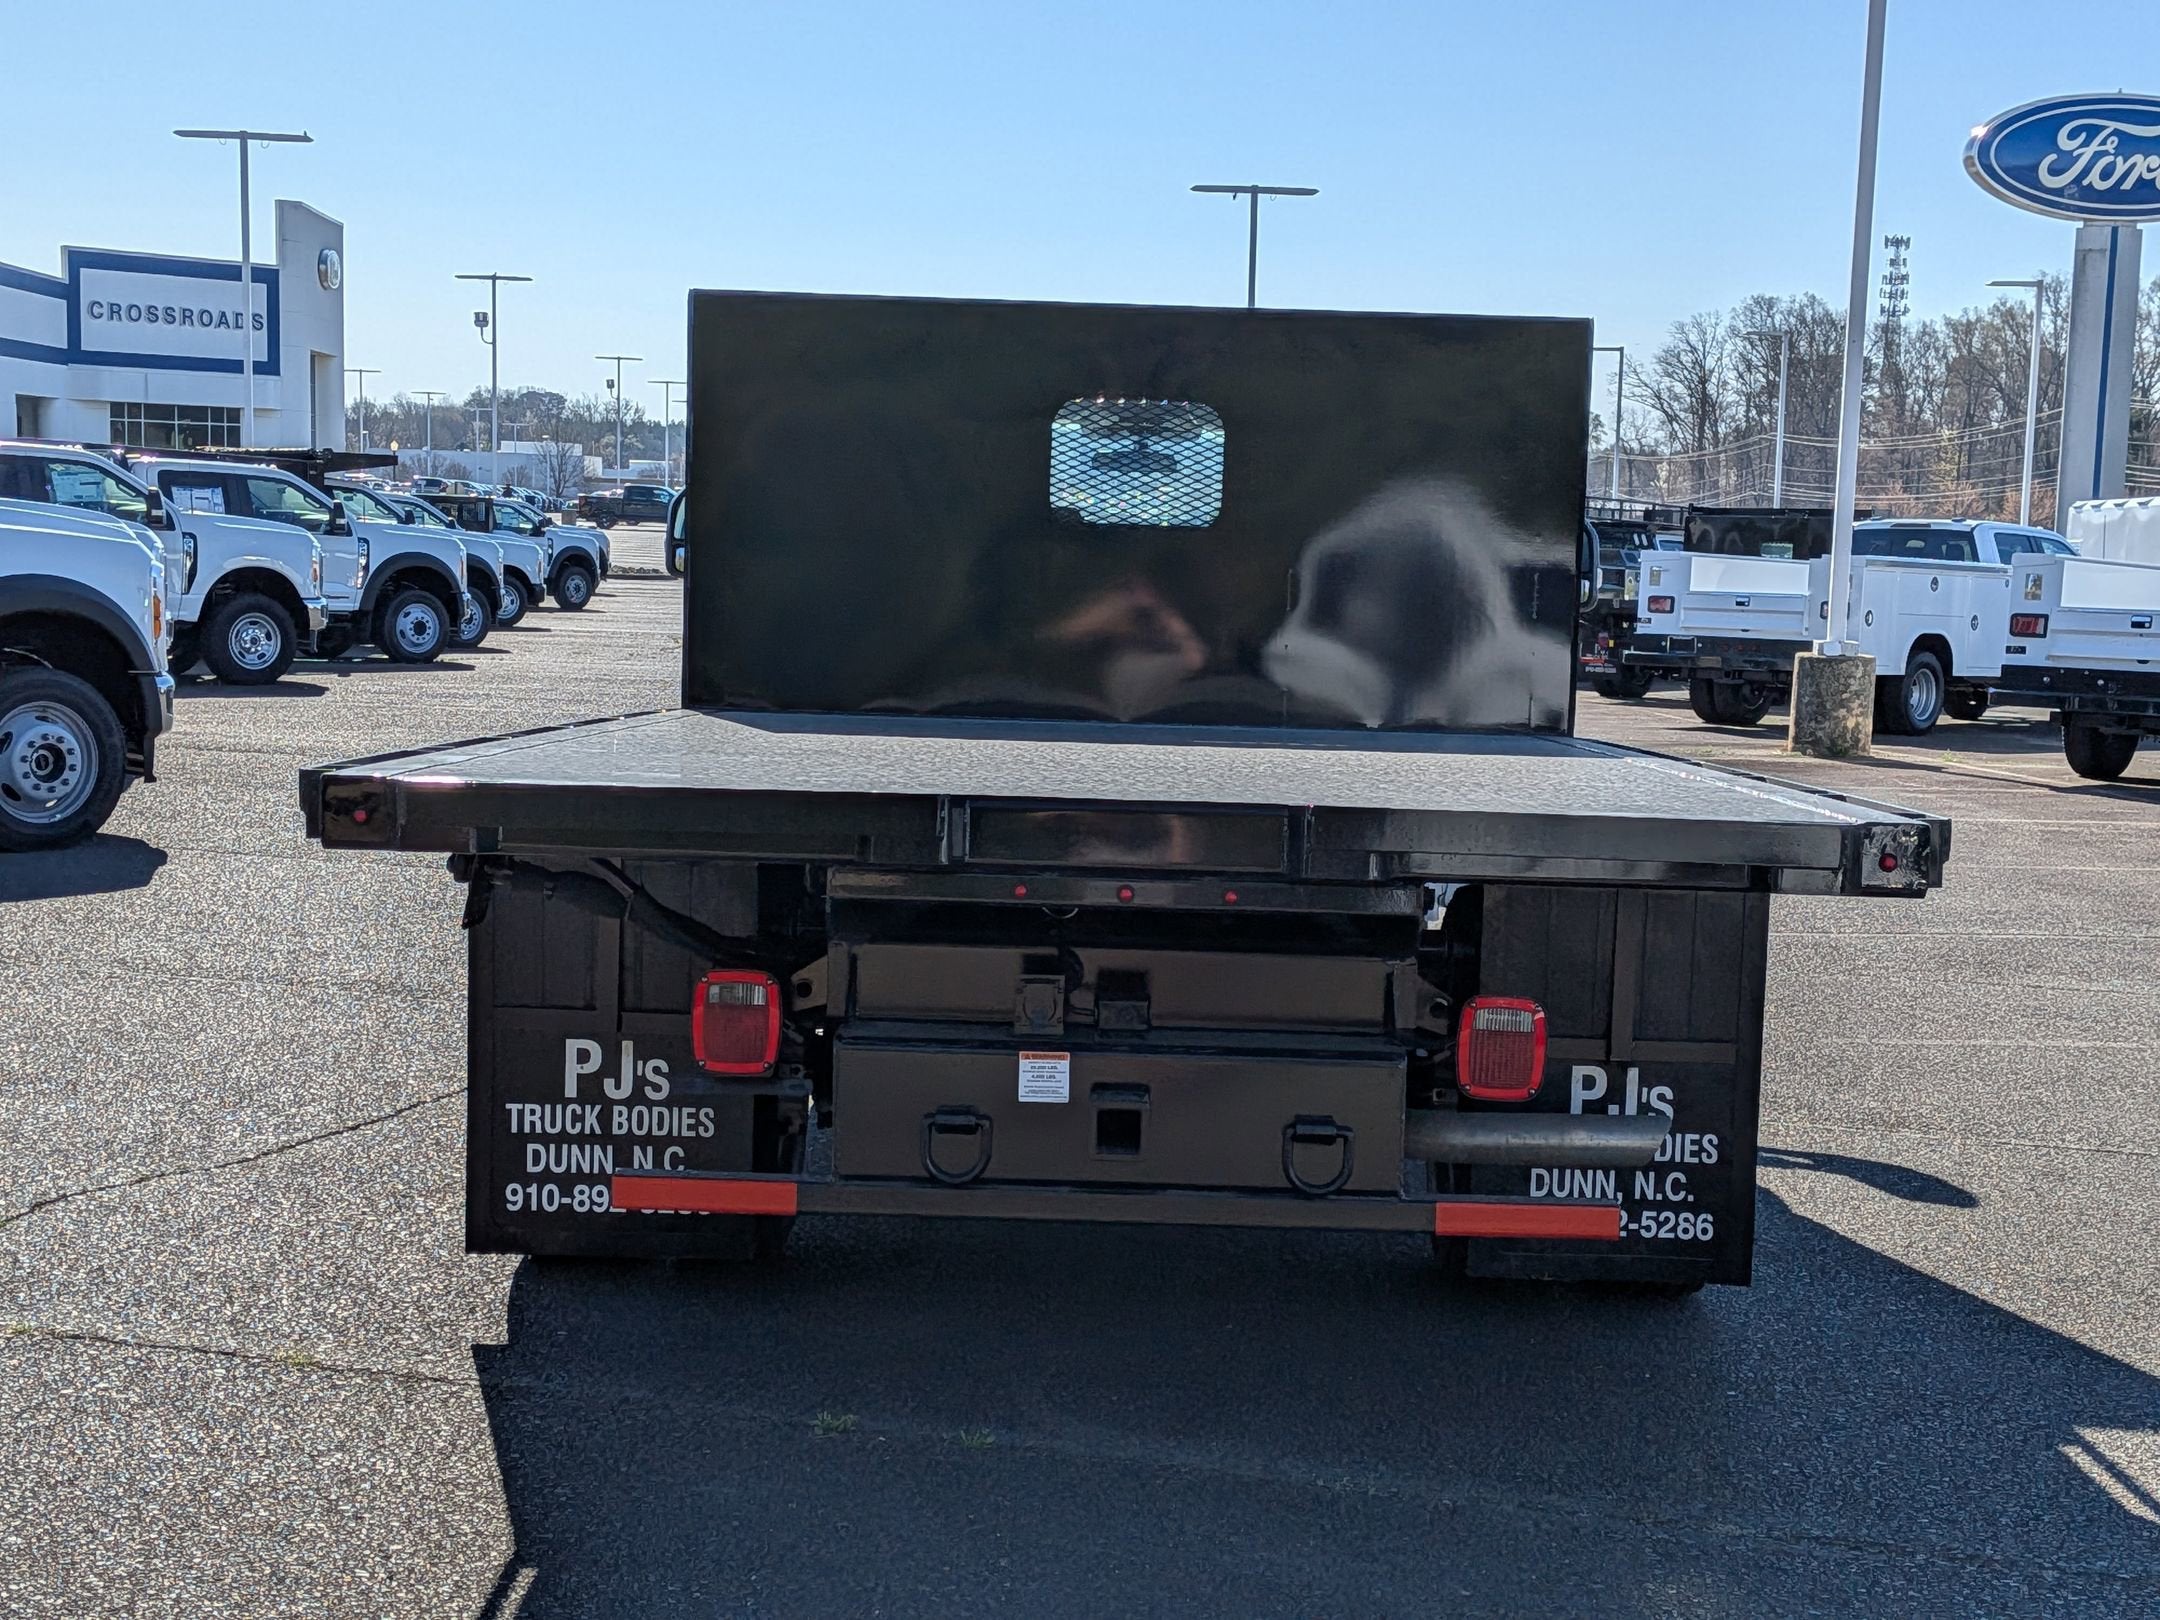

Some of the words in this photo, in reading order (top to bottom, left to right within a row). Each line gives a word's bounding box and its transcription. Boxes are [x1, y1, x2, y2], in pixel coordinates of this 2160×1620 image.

[2038, 118, 2160, 190] For
[88, 300, 264, 331] CROSSROADS
[505, 1103, 602, 1135] TRUCK
[612, 1105, 715, 1138] BODIES
[1654, 1133, 1719, 1164] DIES
[1529, 1168, 1623, 1205] DUNN,
[1634, 1171, 1695, 1202] N.C.
